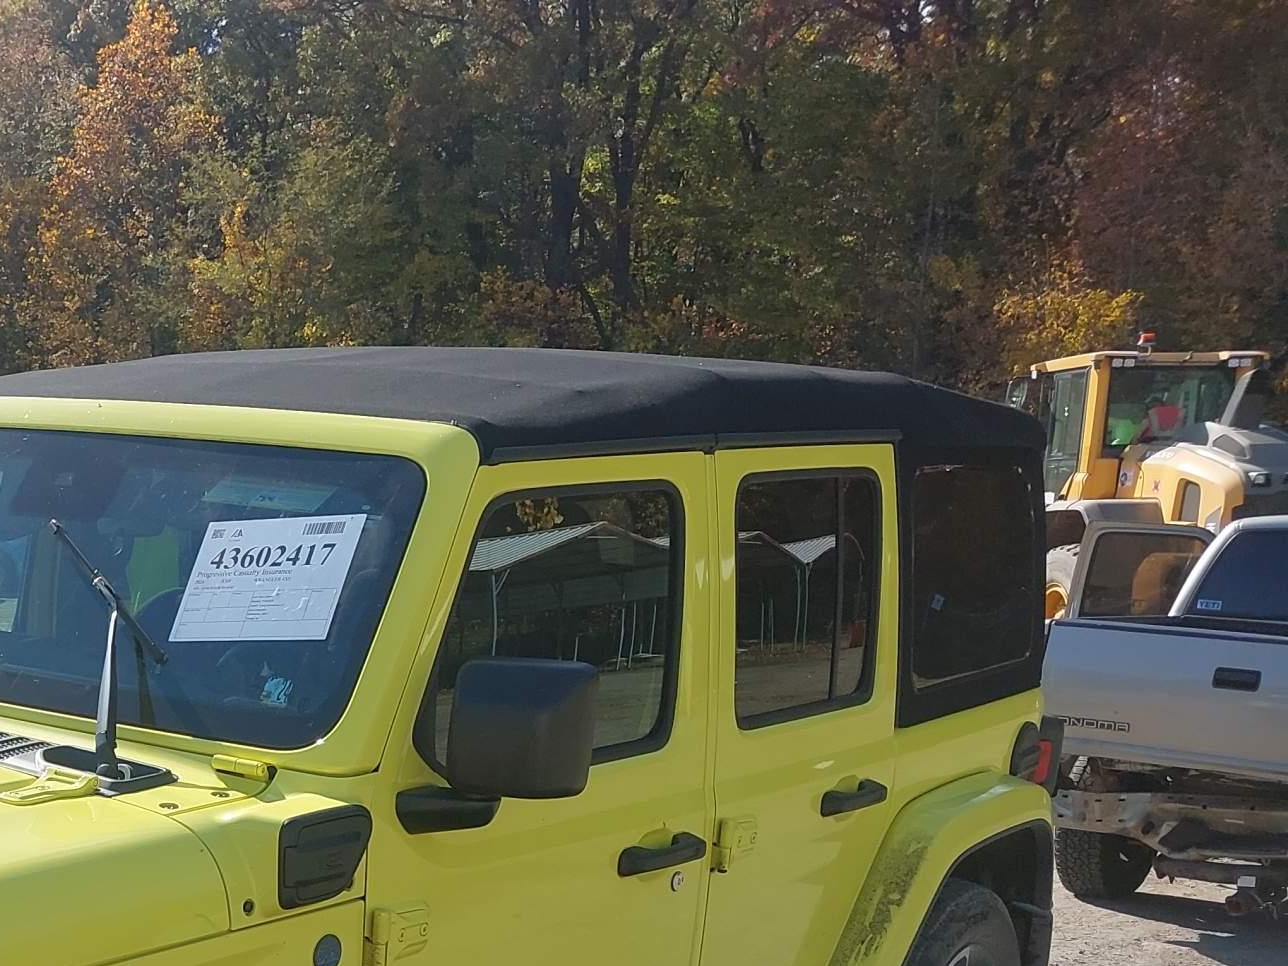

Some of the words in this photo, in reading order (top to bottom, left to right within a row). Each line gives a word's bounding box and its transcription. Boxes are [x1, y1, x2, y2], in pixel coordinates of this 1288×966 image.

[210, 543, 337, 570] 43602417
[196, 571, 232, 579] Progressive
[233, 569, 260, 577] Casualty
[1057, 715, 1130, 733] ONOMA
